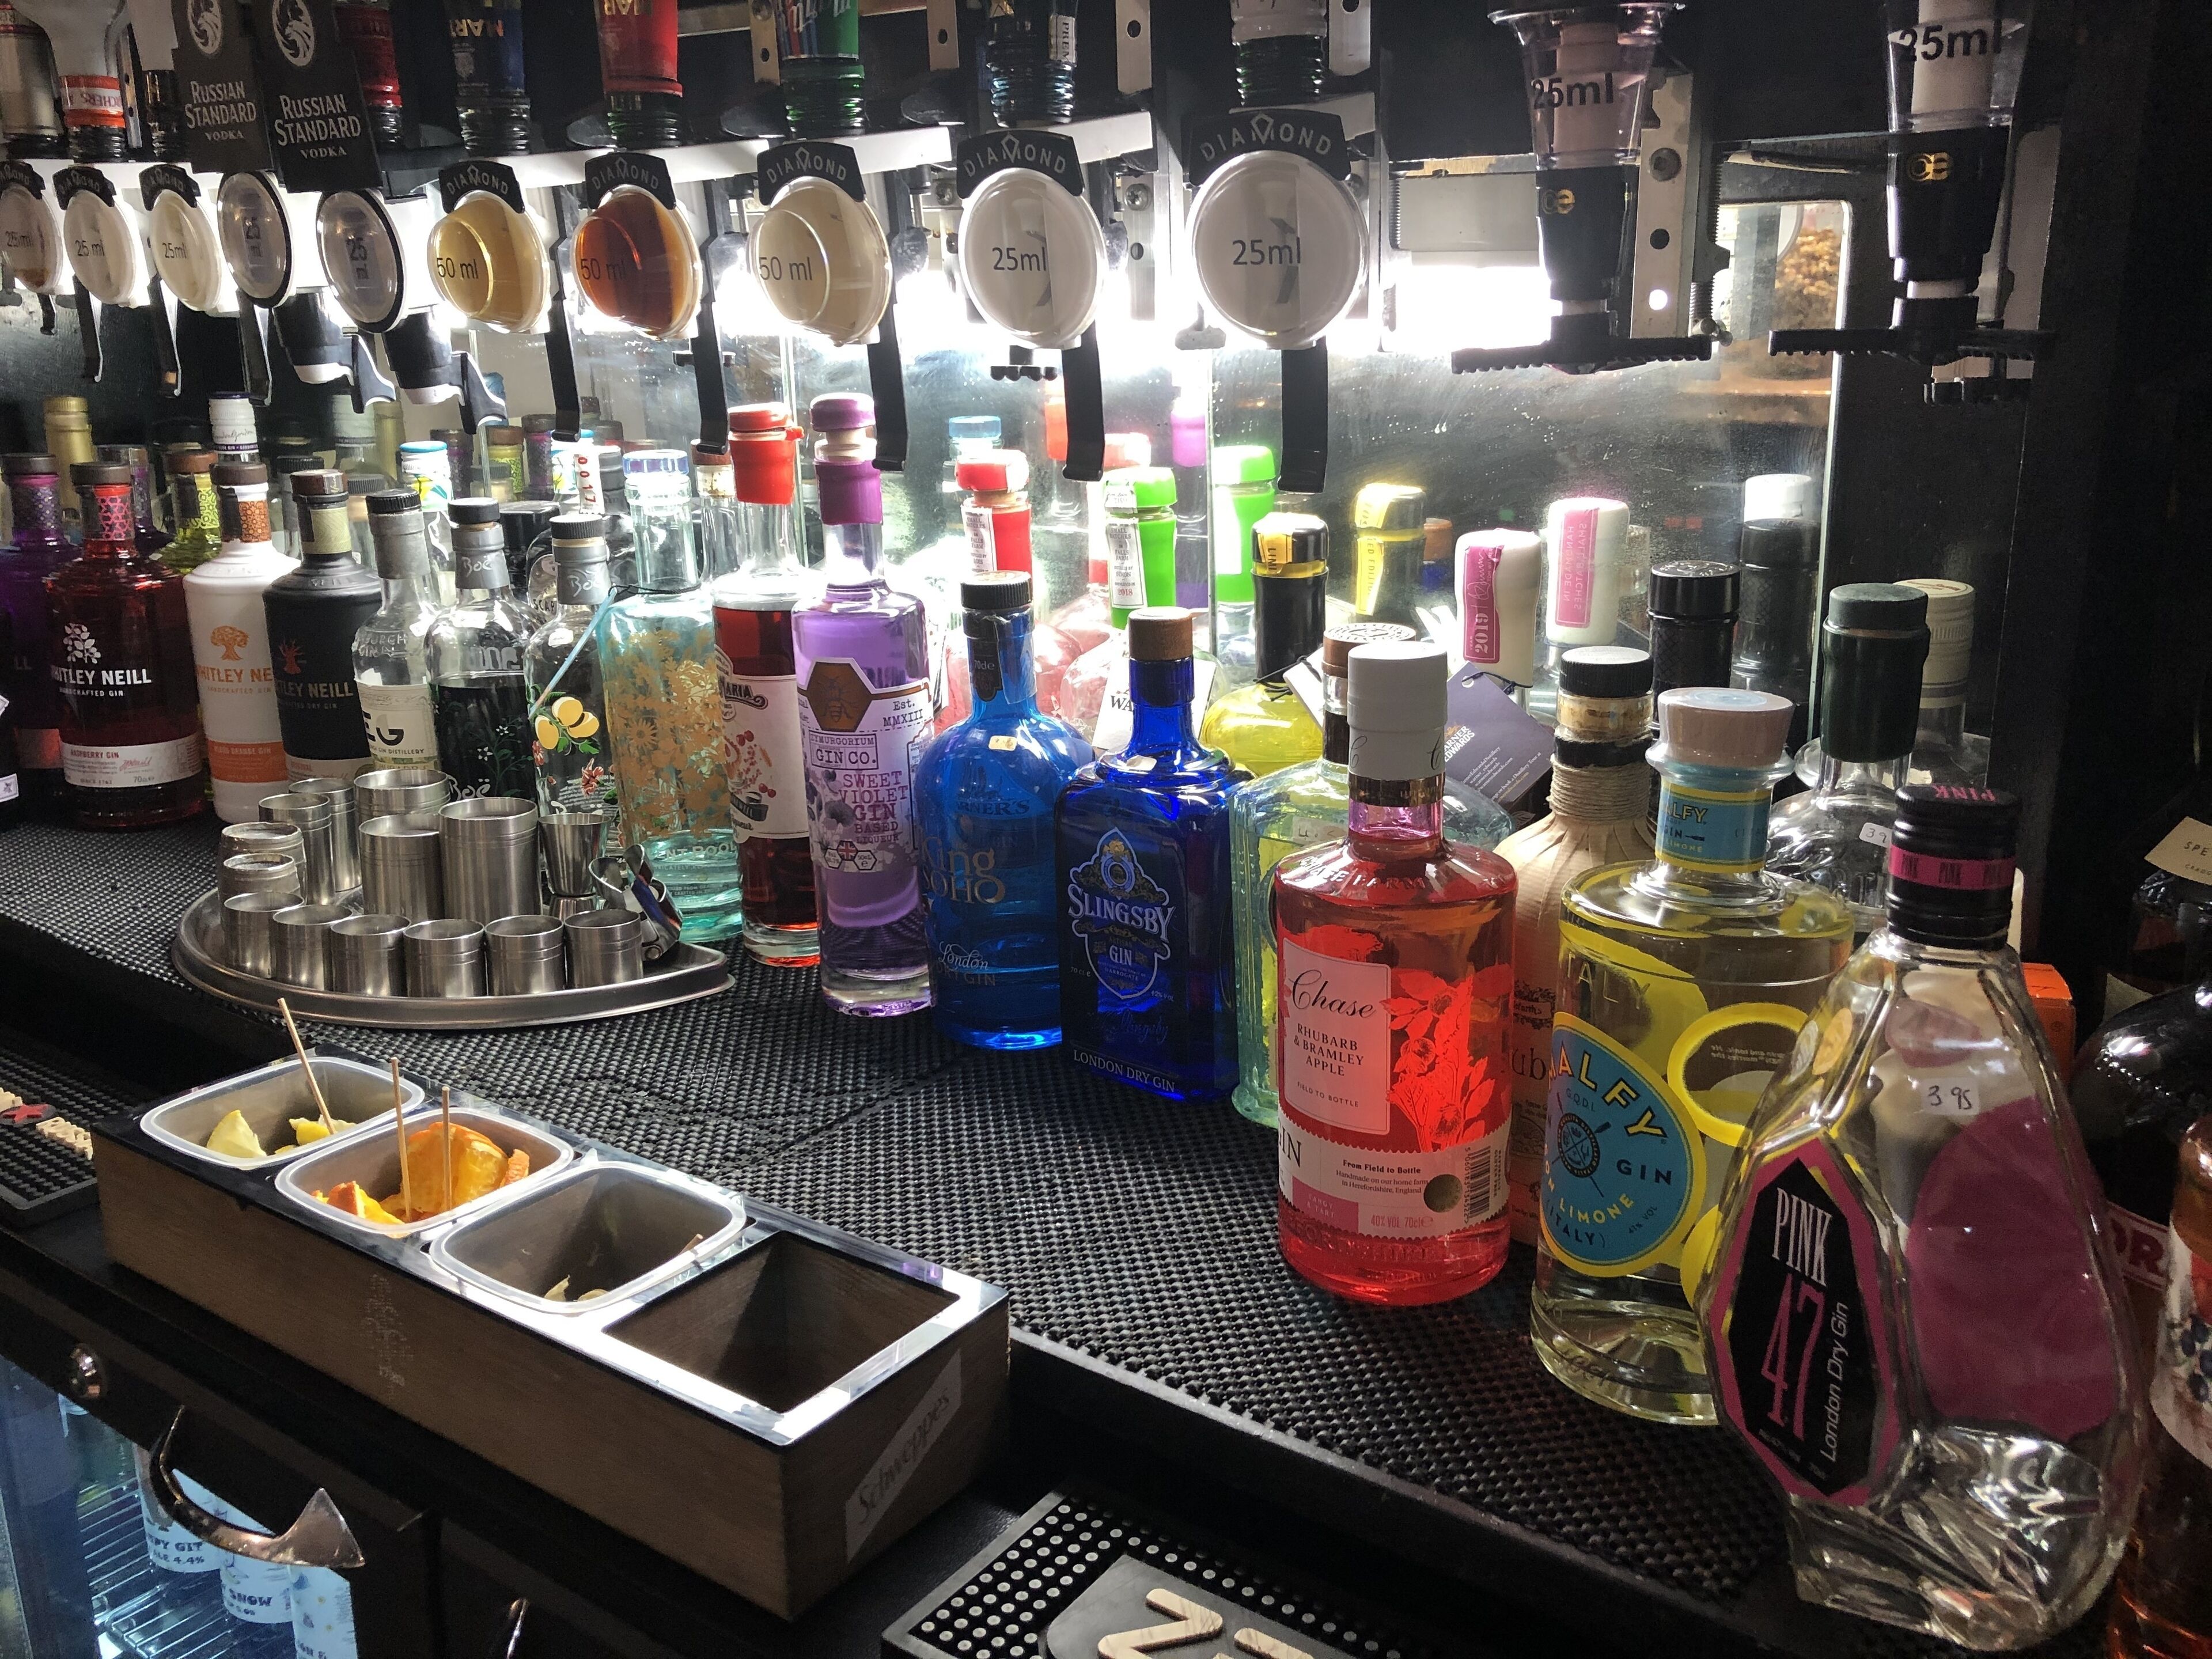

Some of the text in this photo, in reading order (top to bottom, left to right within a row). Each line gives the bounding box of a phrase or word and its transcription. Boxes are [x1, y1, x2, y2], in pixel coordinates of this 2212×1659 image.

[1899, 20, 2001, 62] 25ml
[190, 81, 245, 104] RUSSIAN
[1531, 73, 1613, 110] 25ml
[184, 101, 257, 129] STANDARD
[279, 93, 347, 120] RUSSIAN
[205, 130, 244, 141] VODKA
[274, 115, 362, 146] STANDARD
[1200, 112, 1331, 162] DIAMOND
[300, 146, 347, 159] VODKA
[963, 132, 1067, 178] DIAMOND
[592, 156, 660, 190] DIAMOND
[766, 146, 847, 184] DIAMOND
[446, 164, 509, 195] DIAMOND
[992, 245, 1048, 272] 25ml
[1232, 237, 1301, 267] 25ml
[436, 257, 479, 279] 50 ml
[581, 257, 627, 280] 50 ml
[759, 257, 813, 281] 50 ml
[533, 599, 555, 612] SCAP
[1475, 613, 1488, 654] 2019
[101, 669, 151, 685] NEILL
[250, 668, 273, 683] NE
[308, 681, 354, 698] NEILL
[892, 699, 915, 711] Est.
[1111, 695, 1133, 713] WA
[883, 709, 923, 727] MMXIII
[810, 734, 874, 745] ZYMURGORIUM
[1444, 725, 1470, 751] ARNER
[107, 751, 119, 759] GIN
[816, 749, 876, 764] GIN CO.
[1513, 762, 1530, 779] Distillery
[1527, 756, 1537, 765] Tour
[843, 771, 903, 788] SWEET
[839, 786, 908, 804] VIOLET
[1931, 783, 1997, 802] PINK
[854, 804, 896, 821] GIN
[854, 821, 899, 834] BASED
[856, 833, 900, 844] LIQUEUR
[693, 842, 737, 858] POOL
[2184, 841, 2209, 857] SPE
[1068, 884, 1176, 943] SLINGSBY
[938, 941, 989, 972] London
[1109, 945, 1132, 966] GIN
[964, 972, 995, 986] GIN
[1560, 953, 1653, 1011] TALY
[1163, 994, 1175, 1002] VOL
[1288, 969, 1377, 1018] Chase
[1297, 1023, 1358, 1052] RHUBARB
[1293, 1035, 1365, 1066] & BRAMLEY
[1073, 1050, 1176, 1094] LONDON DRY GIN
[1305, 1056, 1346, 1077] APPLE
[1513, 1047, 1547, 1081] ub
[1297, 1081, 1359, 1108] FIELD TO BOTTLE
[1926, 1086, 1972, 1109] 3 95
[1336, 1169, 1369, 1182] Handmade
[1343, 1159, 1362, 1169] From
[1365, 1164, 1384, 1173] Field
[1616, 1158, 1672, 1185] GIN
[1349, 1181, 1394, 1194] Herefordshire,
[1315, 1207, 1335, 1218] TART
[1560, 1194, 1635, 1224] LIMONE
[1643, 1206, 1657, 1220] VOL
[1371, 1215, 1421, 1228] 40% VOL 70cl
[1546, 1199, 1605, 1248] (ITALY)
[1772, 1187, 1832, 1287] PINK
[1761, 1272, 1825, 1440] 47
[1820, 1301, 1849, 1463] London Dry Gin
[175, 1541, 203, 1552] GIT
